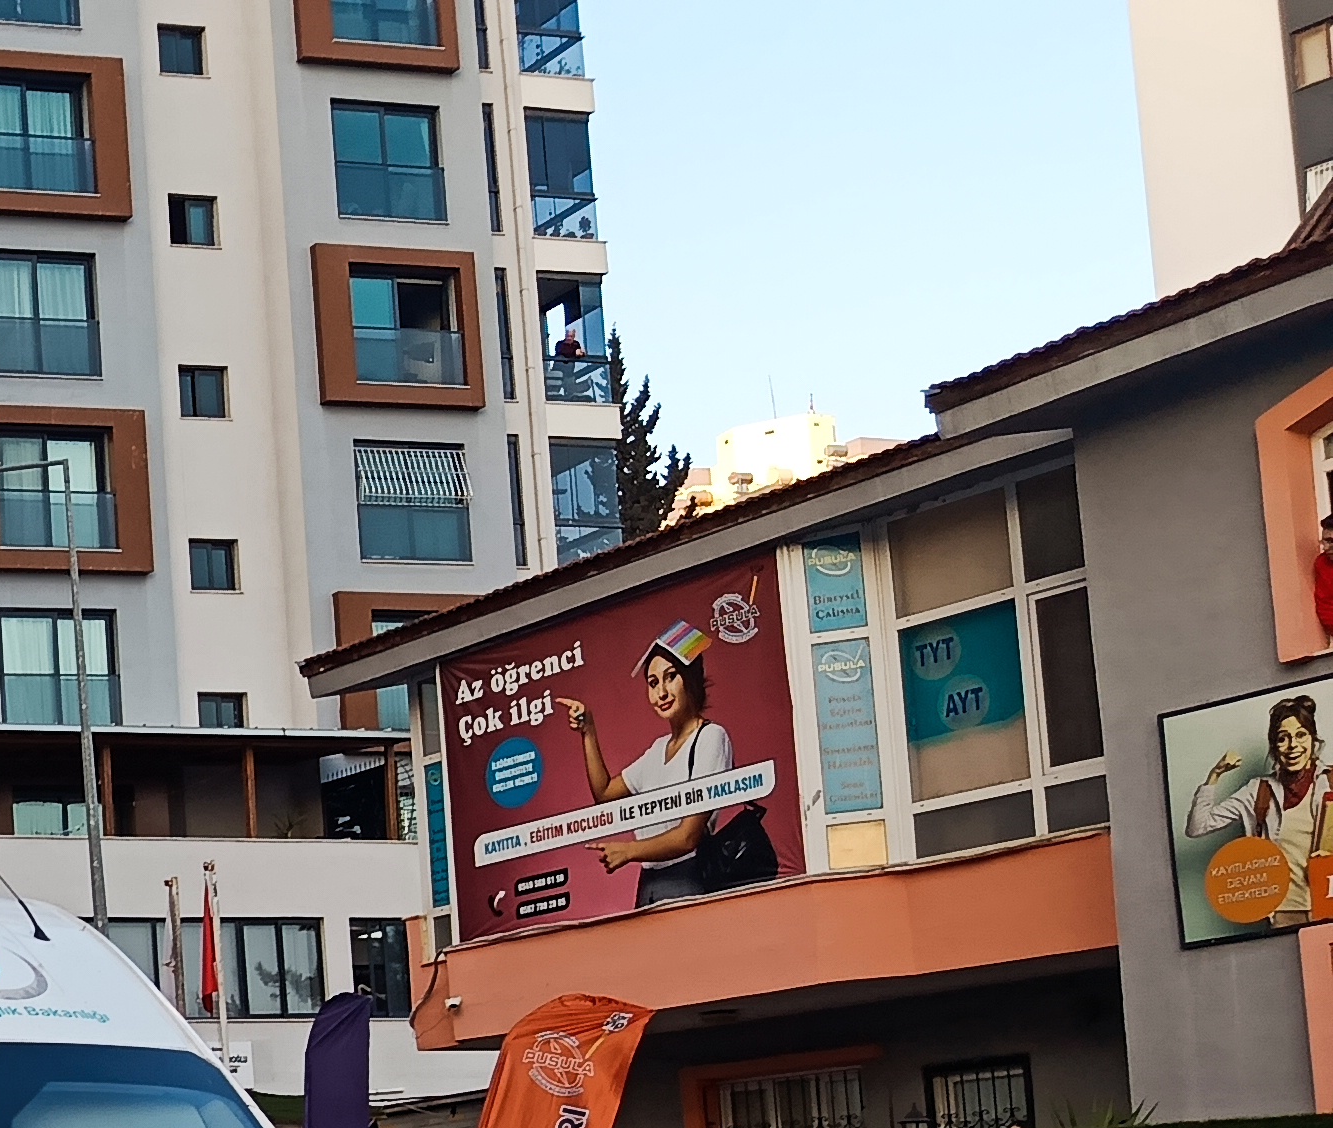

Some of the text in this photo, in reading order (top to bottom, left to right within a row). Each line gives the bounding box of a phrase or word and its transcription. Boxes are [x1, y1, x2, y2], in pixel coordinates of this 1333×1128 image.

[710, 605, 760, 631] PUSULA
[817, 659, 865, 672] PUSULA
[915, 636, 954, 667] TYT
[455, 640, 584, 705] Az öğrenci
[945, 687, 983, 718] AYT
[458, 689, 554, 746] Çok ilgi
[484, 834, 522, 855] KAYITTA
[530, 825, 564, 844] EĞİTİM
[566, 810, 614, 834] KOÇLUĞU
[619, 805, 635, 822] İLE
[638, 792, 682, 817] YEPYENİ
[685, 787, 704, 805] BİR
[706, 773, 763, 800] YAKLAŞIM
[1227, 873, 1268, 888] DEVAM
[24, 1006, 110, 1023] Bakanlığı
[522, 1049, 595, 1077] PUSULA
